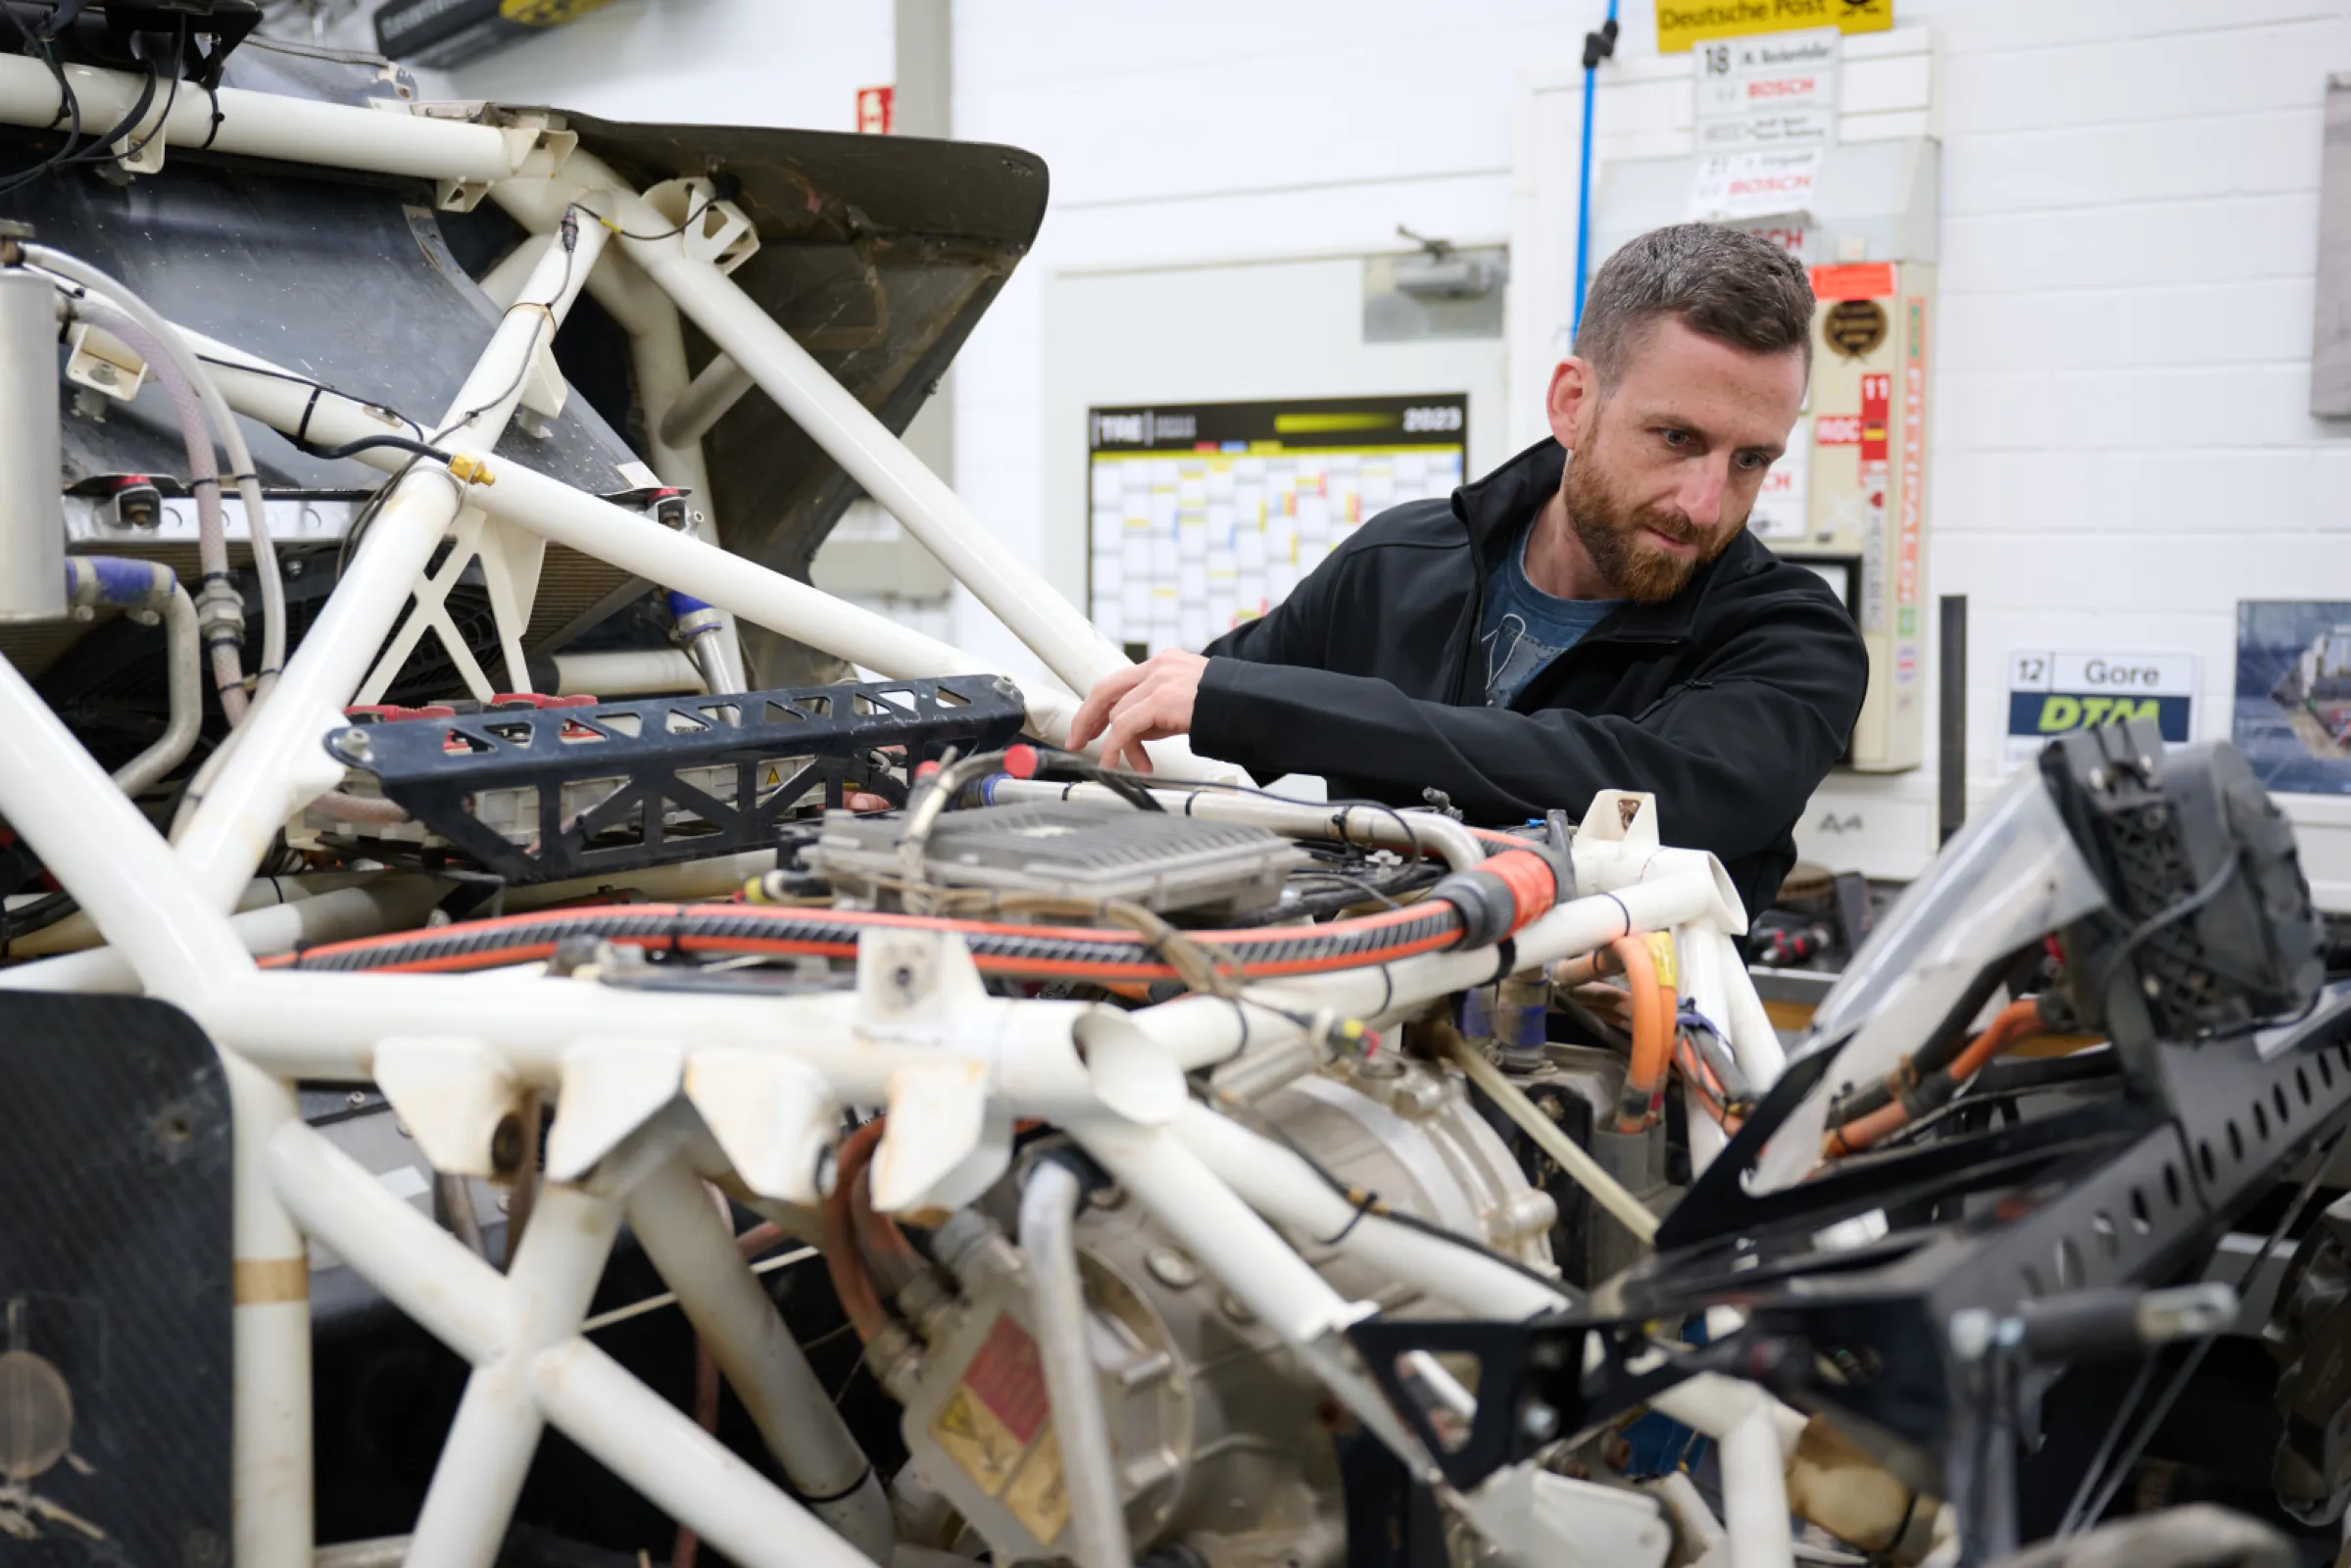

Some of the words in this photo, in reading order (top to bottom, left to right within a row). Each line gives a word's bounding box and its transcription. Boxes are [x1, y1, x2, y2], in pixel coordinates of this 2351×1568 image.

[1660, 1, 1768, 30] Deutsche
[1773, 0, 1827, 17] Post
[1705, 44, 1731, 76] 18
[1748, 77, 1815, 100] BOSCH
[1729, 173, 1813, 196] BOSCH
[1402, 406, 1462, 432] 2023
[2019, 659, 2044, 682] 12
[2084, 660, 2160, 686] Gore
[2037, 697, 2160, 732] DTM
